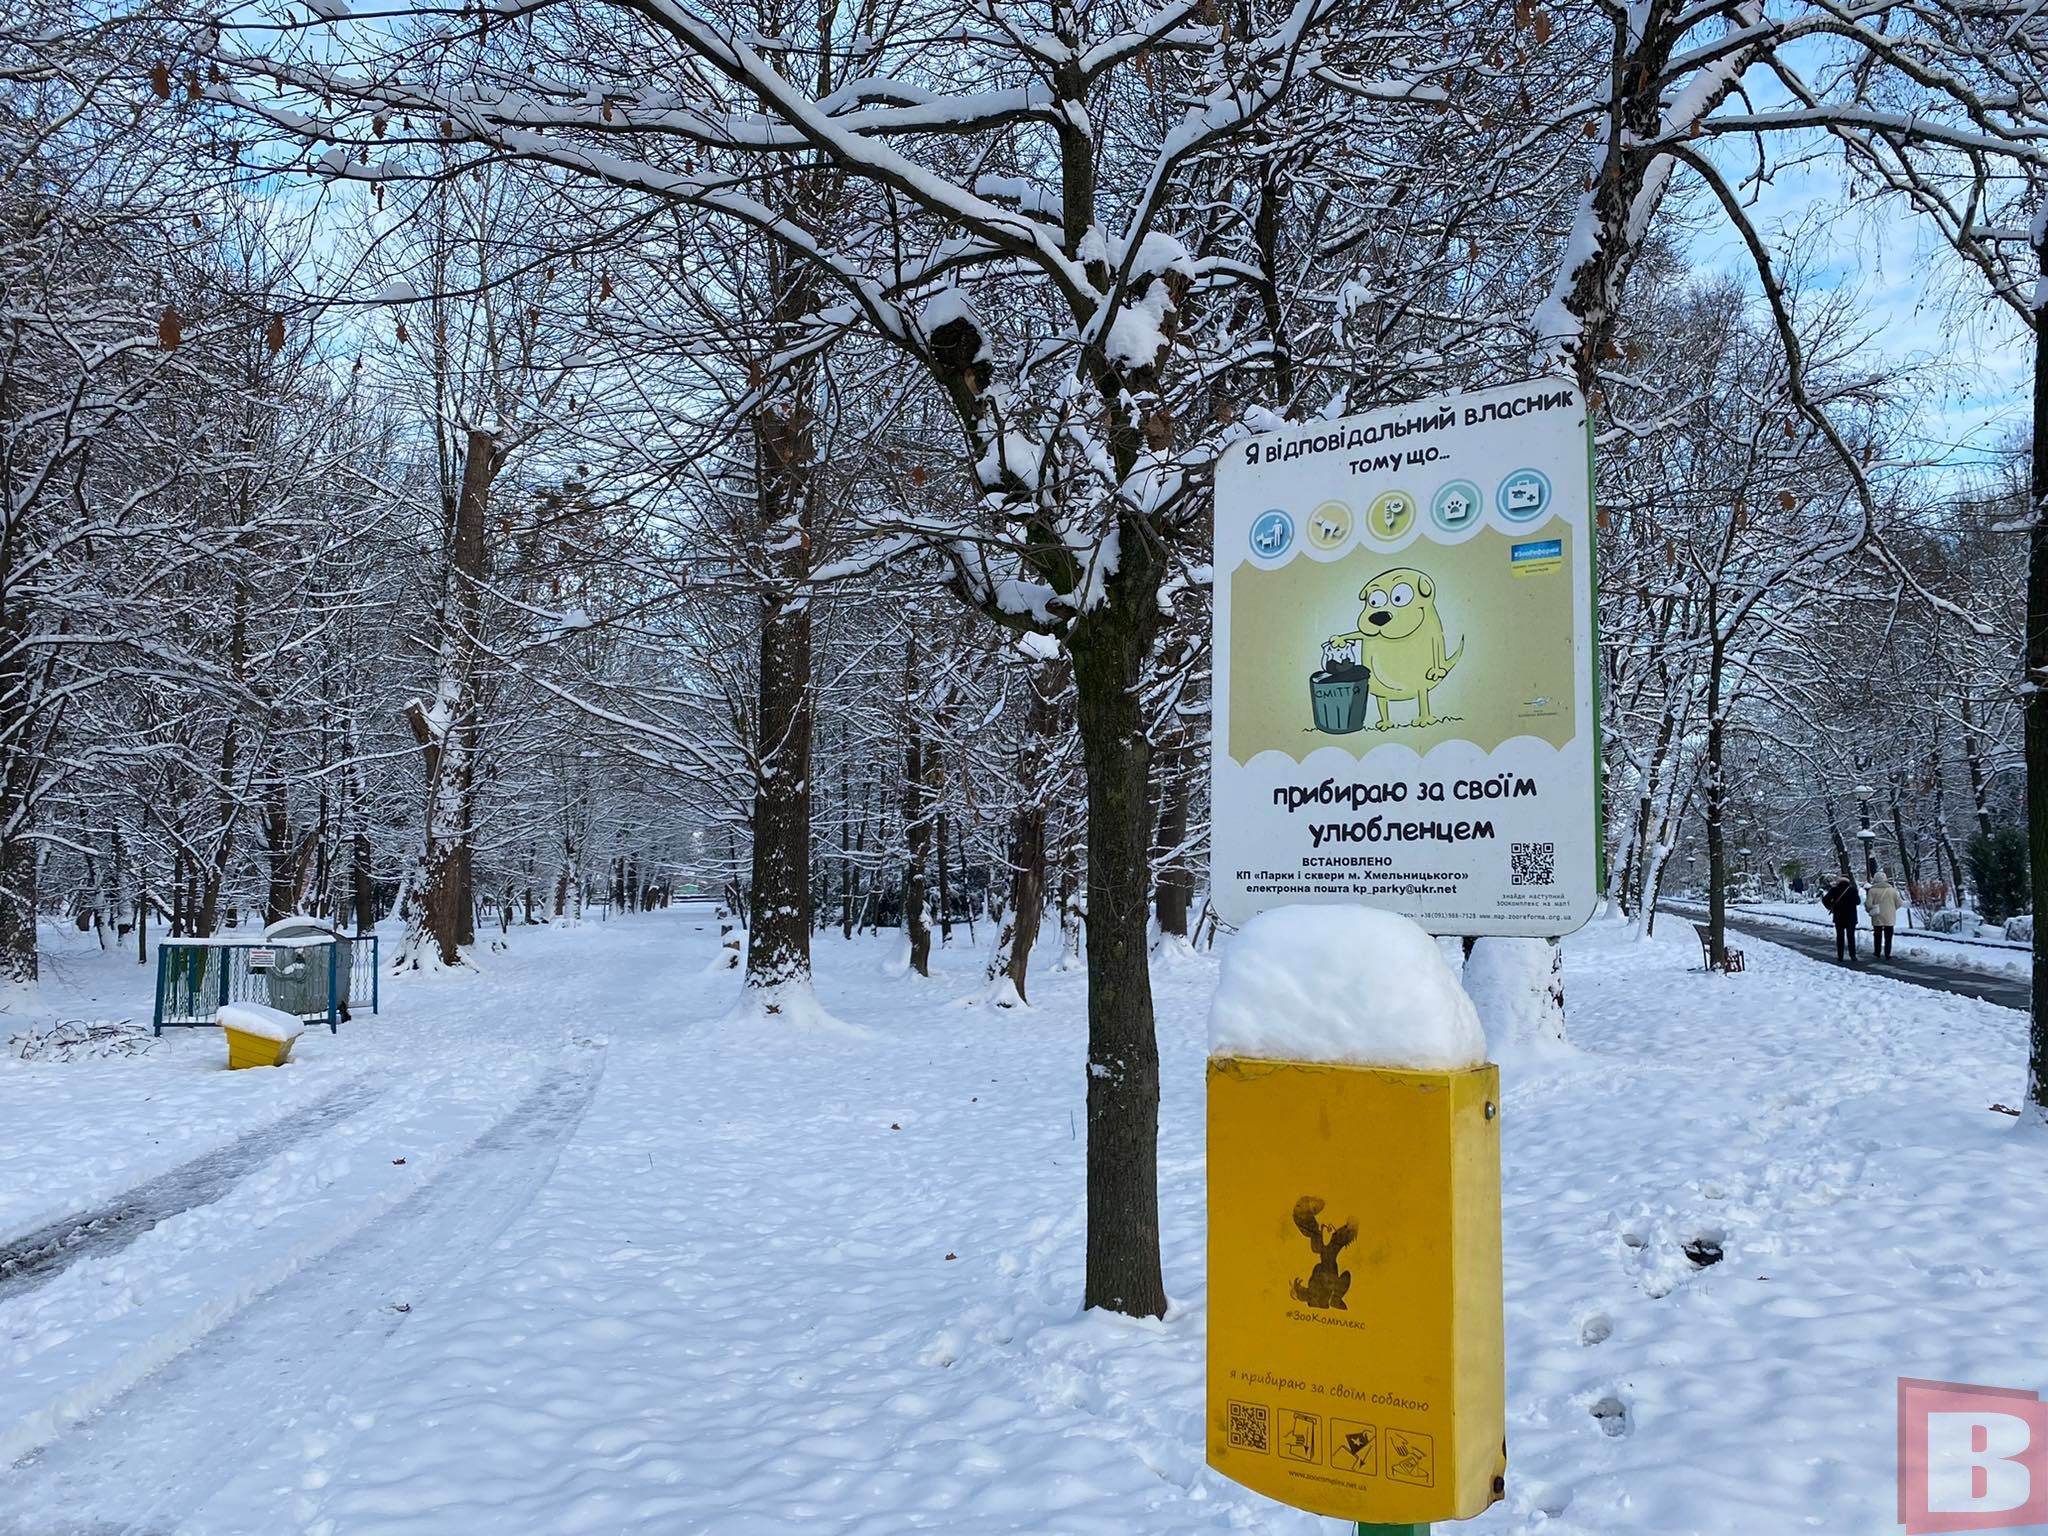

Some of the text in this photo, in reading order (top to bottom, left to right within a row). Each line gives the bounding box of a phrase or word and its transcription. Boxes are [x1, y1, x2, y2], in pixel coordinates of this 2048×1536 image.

[1245, 390, 1574, 466] Я відповідальний власник
[1349, 452, 1403, 475] тому
[1273, 772, 1537, 813] прибираю за своїм
[1308, 814, 1495, 848] улюбленцем
[1302, 856, 1392, 867] ВСТАНОВЛЕНО
[1236, 871, 1251, 880] КП
[1254, 871, 1294, 882] «Парки
[1304, 872, 1344, 882] сквери
[1348, 872, 1360, 880] м.
[1364, 870, 1469, 882] Хмельницького»
[1246, 882, 1457, 895] електронна пошта kp_parky@ukr.net
[1286, 1310, 1366, 1330] #ЗооКомплекс
[1241, 1371, 1306, 1391] прибираю
[1311, 1384, 1325, 1395] за
[1329, 1384, 1366, 1401] своїм
[1371, 1391, 1430, 1412] собакою
